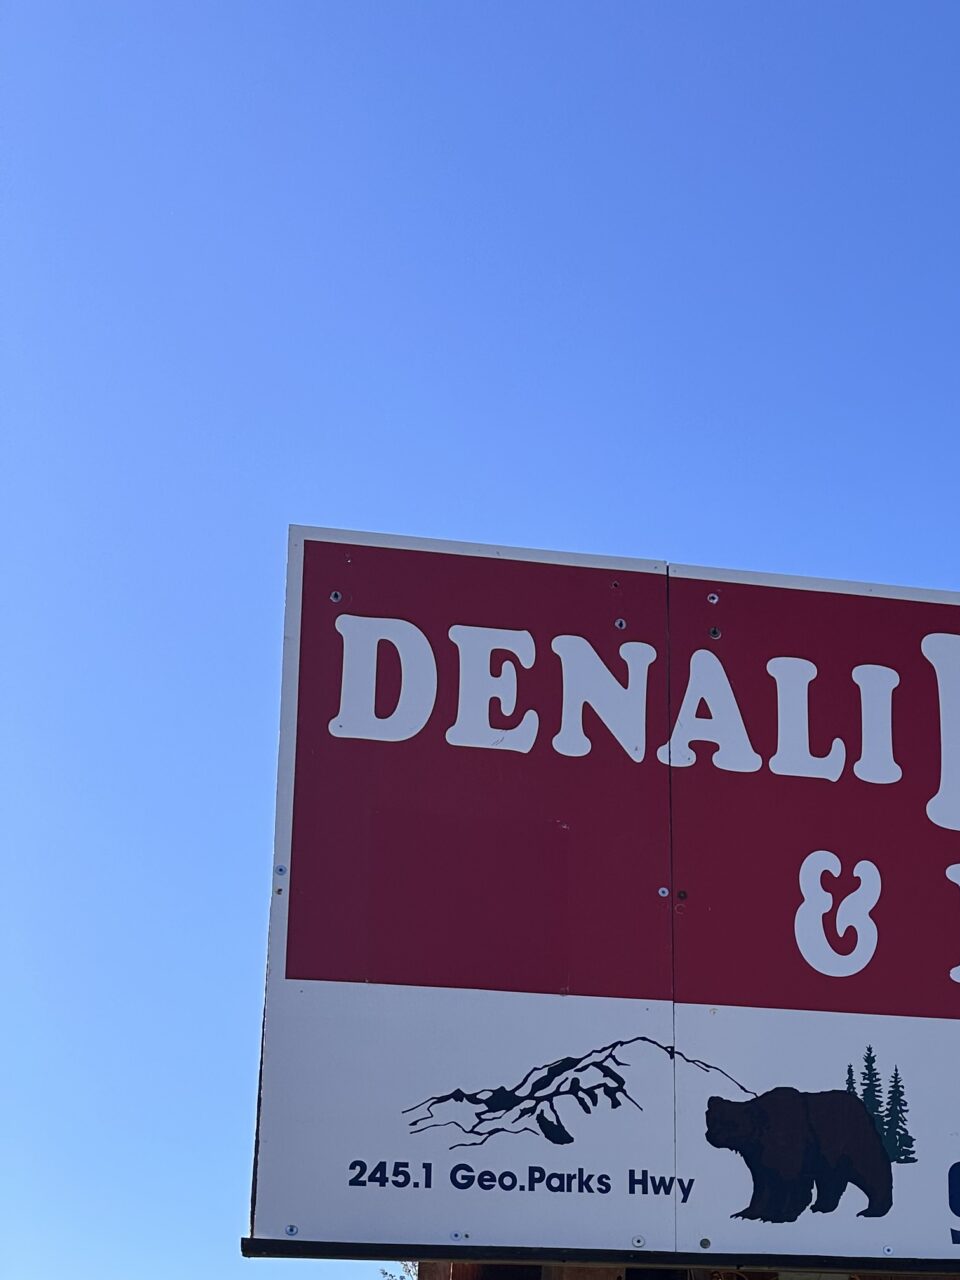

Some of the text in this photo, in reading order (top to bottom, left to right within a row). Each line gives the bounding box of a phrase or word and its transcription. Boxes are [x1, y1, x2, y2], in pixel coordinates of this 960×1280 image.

[328, 613, 903, 785] DENALI
[794, 850, 882, 978] &
[348, 1159, 696, 1204] 245.1 Geo.Parks Hwy
